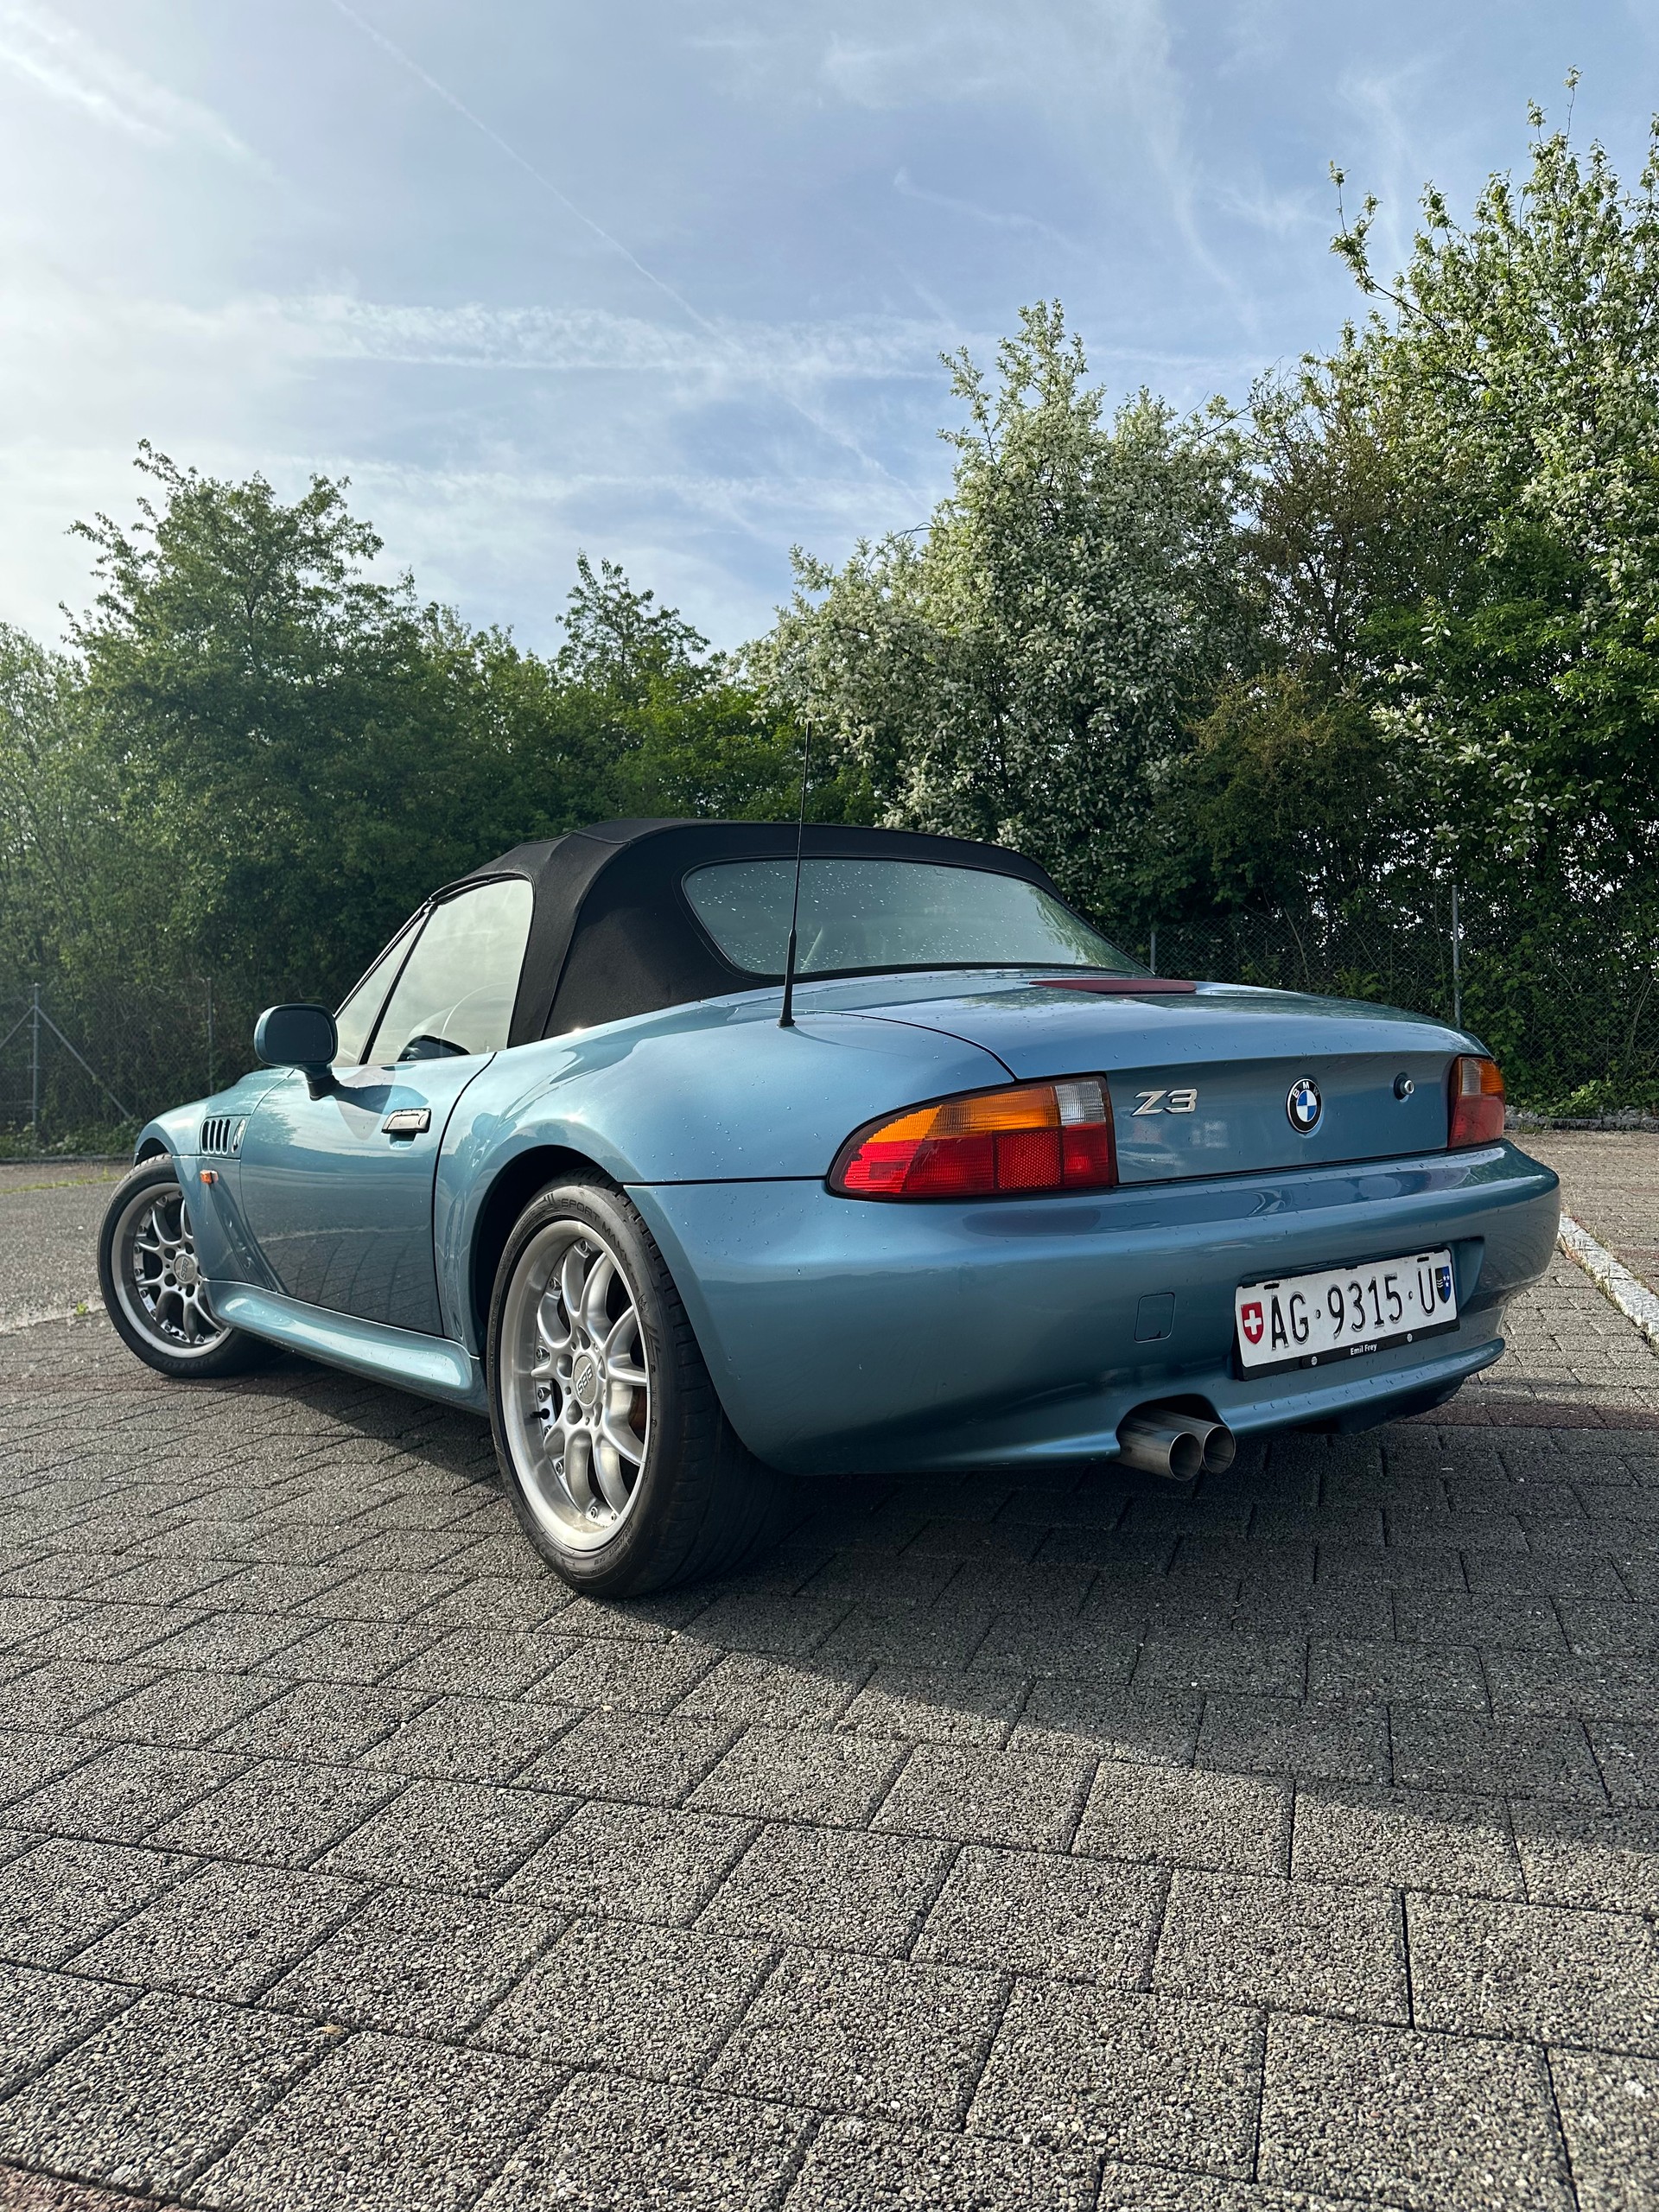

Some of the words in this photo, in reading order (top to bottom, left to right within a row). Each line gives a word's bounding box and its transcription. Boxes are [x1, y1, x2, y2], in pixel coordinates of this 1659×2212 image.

[1130, 1088, 1198, 1117] Z3
[1292, 1081, 1319, 1097] BMW
[560, 1198, 601, 1223] SPORT
[601, 1220, 632, 1272] MAXX
[1350, 1345, 1363, 1356] Emil
[1364, 1343, 1377, 1352] Frey
[576, 1363, 594, 1396] BBS
